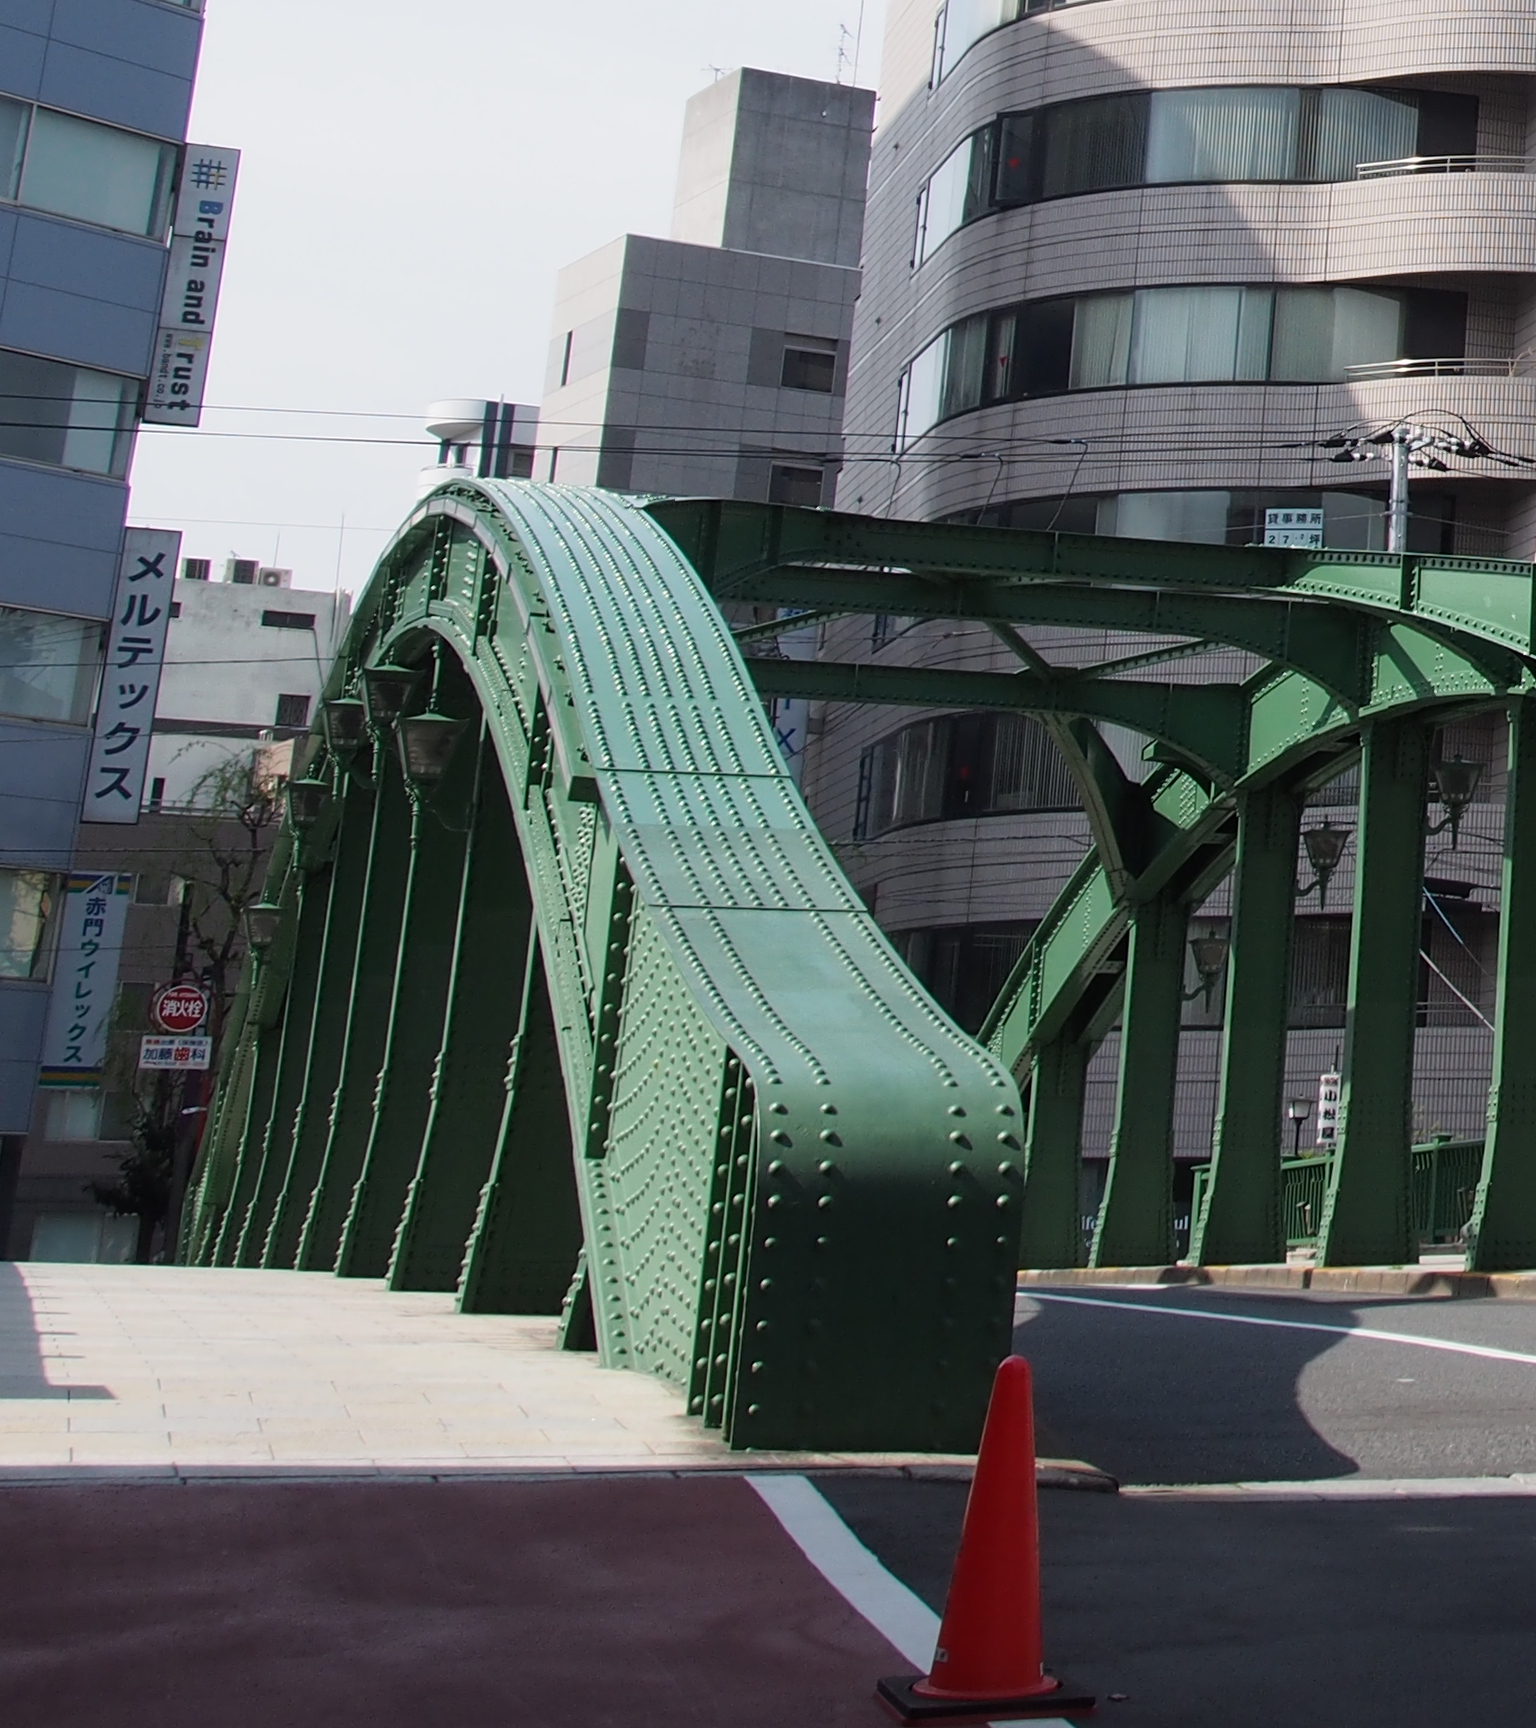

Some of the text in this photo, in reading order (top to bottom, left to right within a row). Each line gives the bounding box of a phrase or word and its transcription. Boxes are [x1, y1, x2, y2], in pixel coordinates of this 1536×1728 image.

[166, 199, 224, 412] Brain and Trust
[1267, 513, 1322, 525] 貸事務所
[94, 551, 167, 800] メルテックス
[63, 896, 108, 1064] 赤門ウイレックス
[161, 999, 203, 1018] 消火栓
